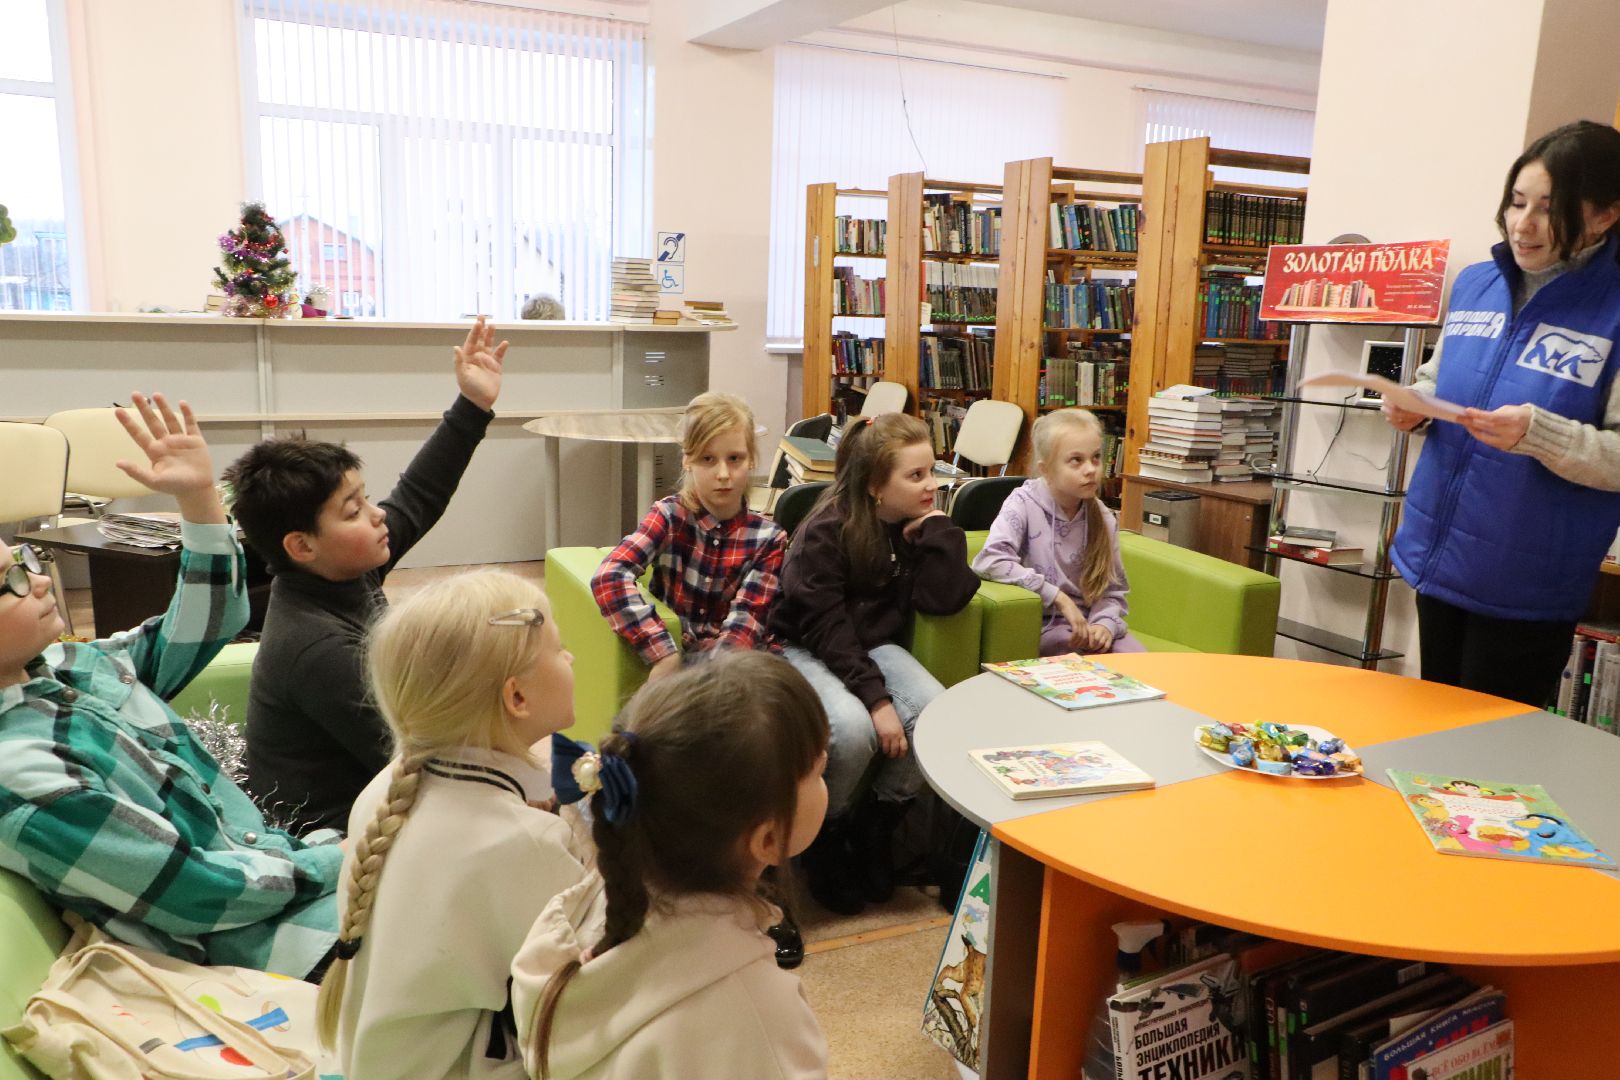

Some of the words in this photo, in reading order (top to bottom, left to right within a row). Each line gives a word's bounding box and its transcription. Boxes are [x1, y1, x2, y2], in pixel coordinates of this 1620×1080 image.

[1283, 250, 1366, 273] ЗОЛОТАЯ
[1369, 247, 1434, 272] ПОЛКА
[1134, 1017, 1188, 1050] БОЛЬШАЯ
[1136, 1022, 1220, 1067] ЭНЦИКЛОПЕДИЯ
[1383, 1031, 1426, 1061] БОЛЬШАЯ
[1430, 1014, 1458, 1034] КНИГА
[1137, 1031, 1246, 1080] ТЕХНИКИ
[1450, 1052, 1471, 1068] ОБО
